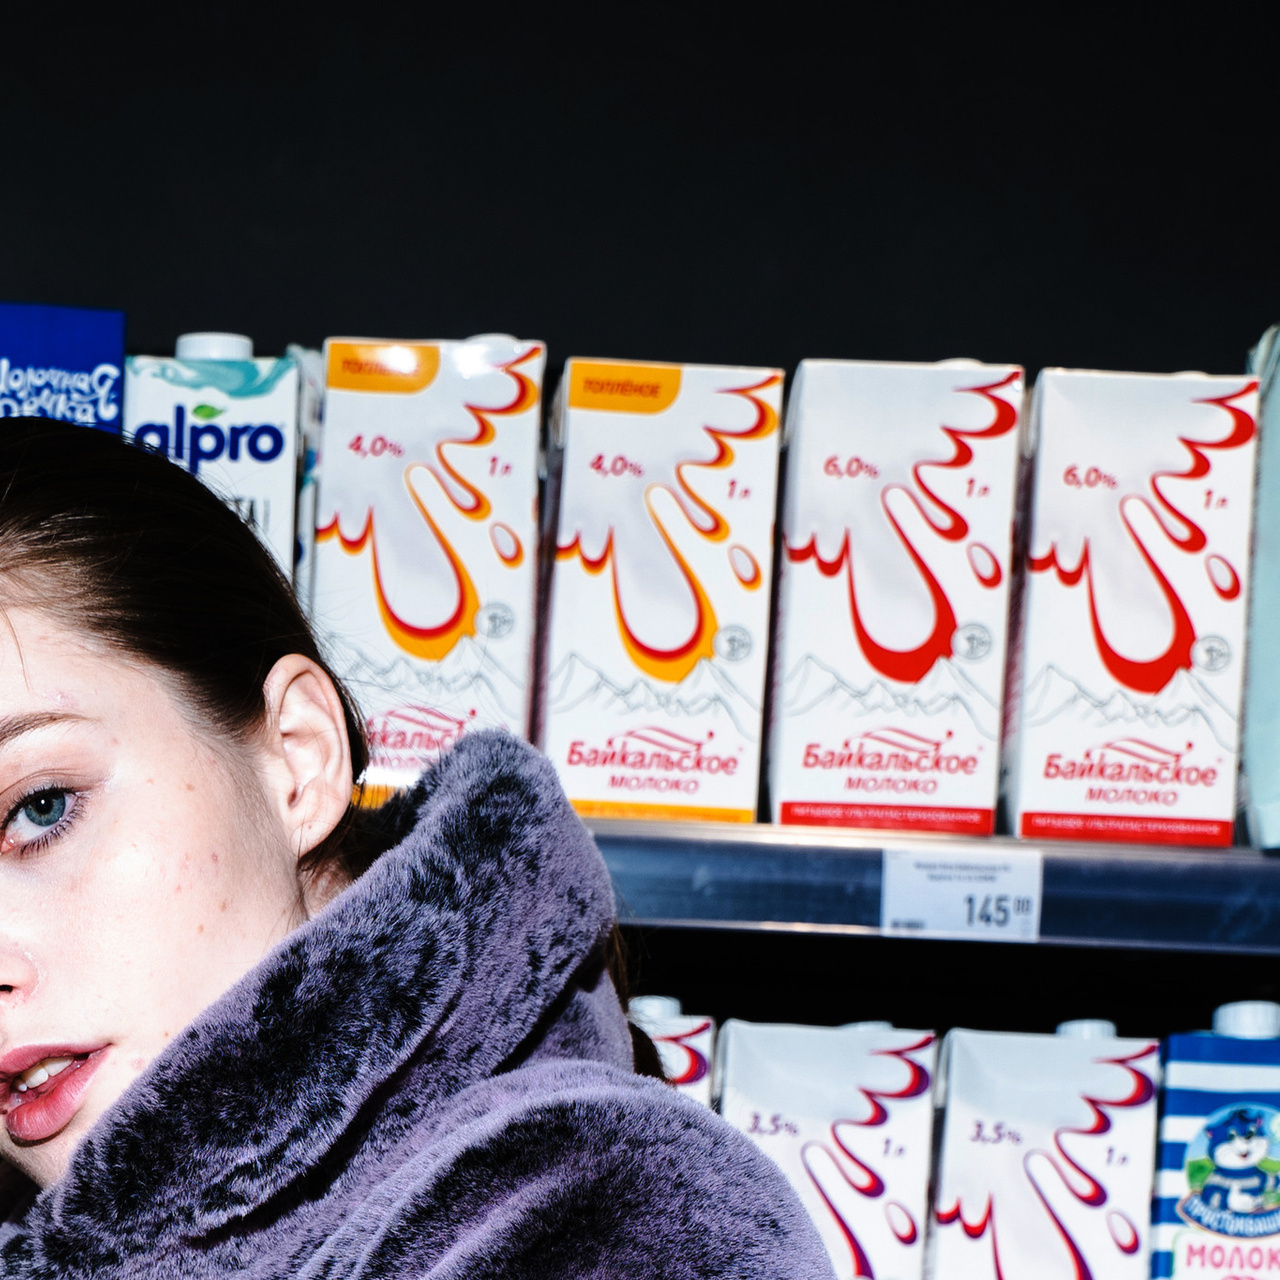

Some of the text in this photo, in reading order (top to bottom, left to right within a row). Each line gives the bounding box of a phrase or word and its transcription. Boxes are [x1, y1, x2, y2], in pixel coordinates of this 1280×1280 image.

[134, 406, 284, 475] alpro
[347, 434, 405, 459] 4,0%
[589, 453, 645, 480] 4,0%
[823, 455, 879, 480] 6,0%
[1063, 464, 1118, 490] 6,0%
[567, 731, 739, 776] Байкальское
[802, 733, 978, 776] Байкальское
[1042, 743, 1218, 788] Байкальское
[608, 775, 700, 795] молоко
[844, 775, 938, 795] молоко
[1085, 786, 1179, 807] молоко
[963, 894, 1010, 928] 145
[1186, 1244, 1280, 1271] МОЛОК
